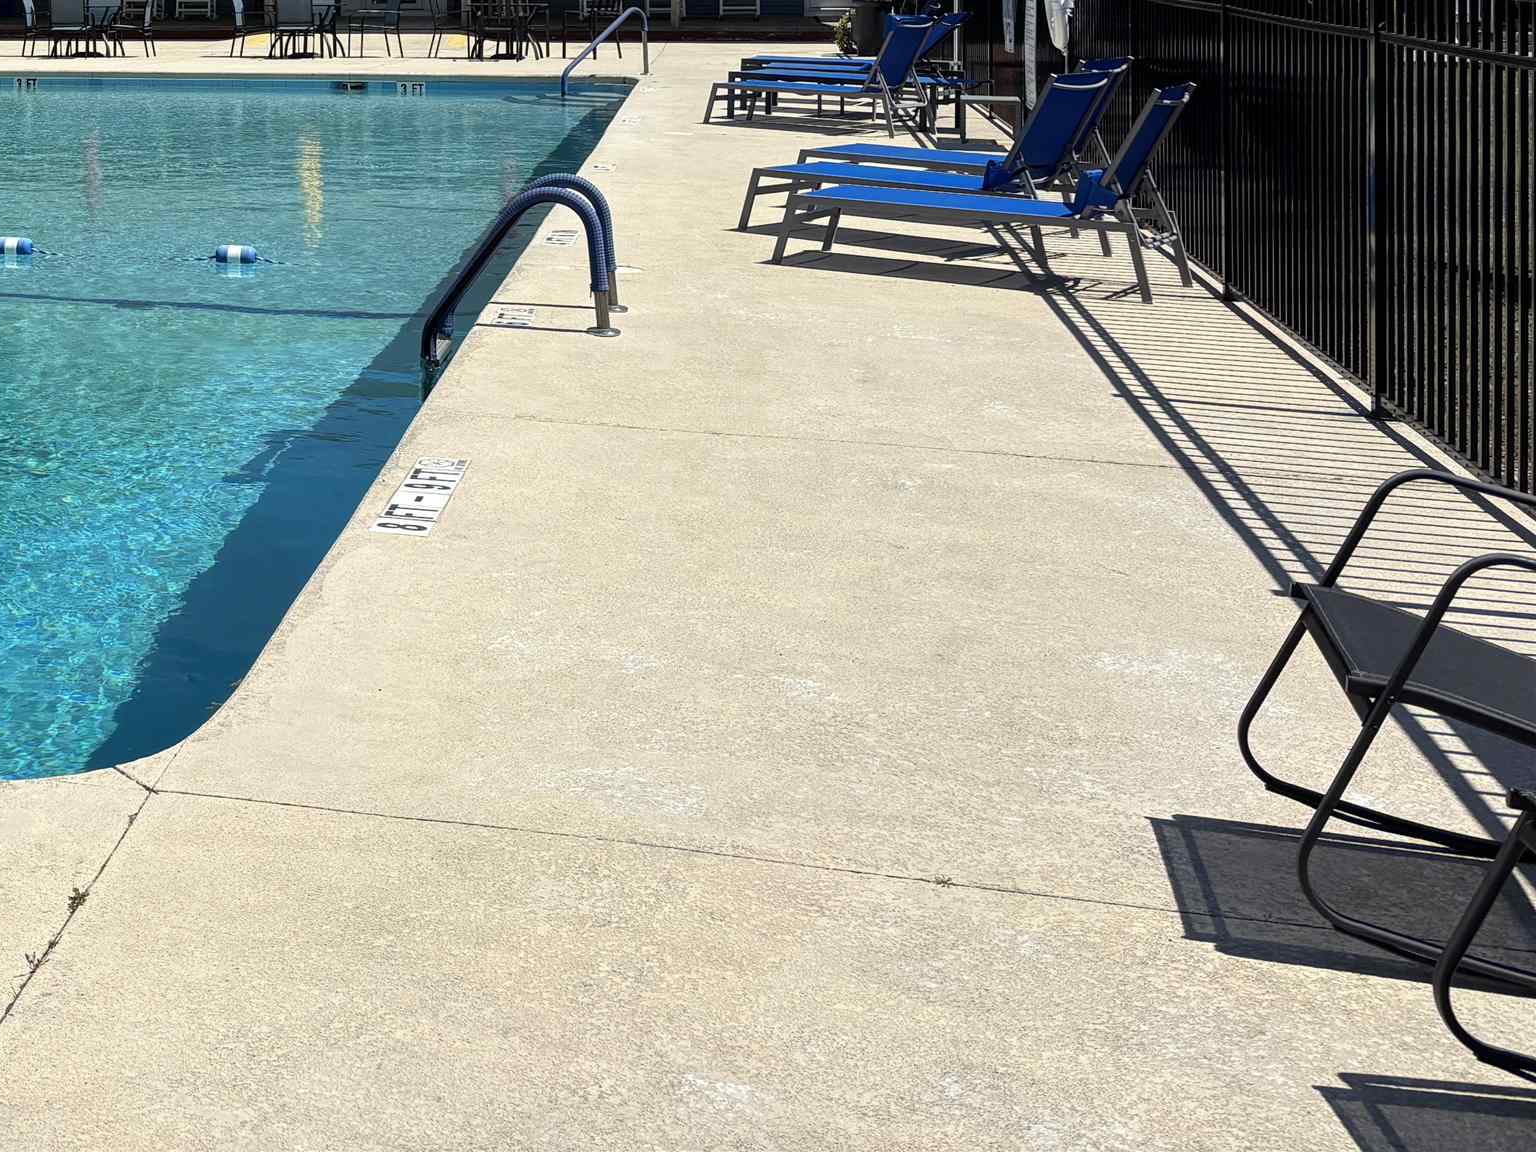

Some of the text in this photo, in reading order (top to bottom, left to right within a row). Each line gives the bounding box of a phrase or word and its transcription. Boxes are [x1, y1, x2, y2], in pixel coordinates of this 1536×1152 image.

[26, 78, 38, 89] FT
[400, 83, 424, 96] 3 FT
[410, 468, 461, 482] FT
[384, 503, 440, 519] FT
[376, 523, 428, 531] 8
